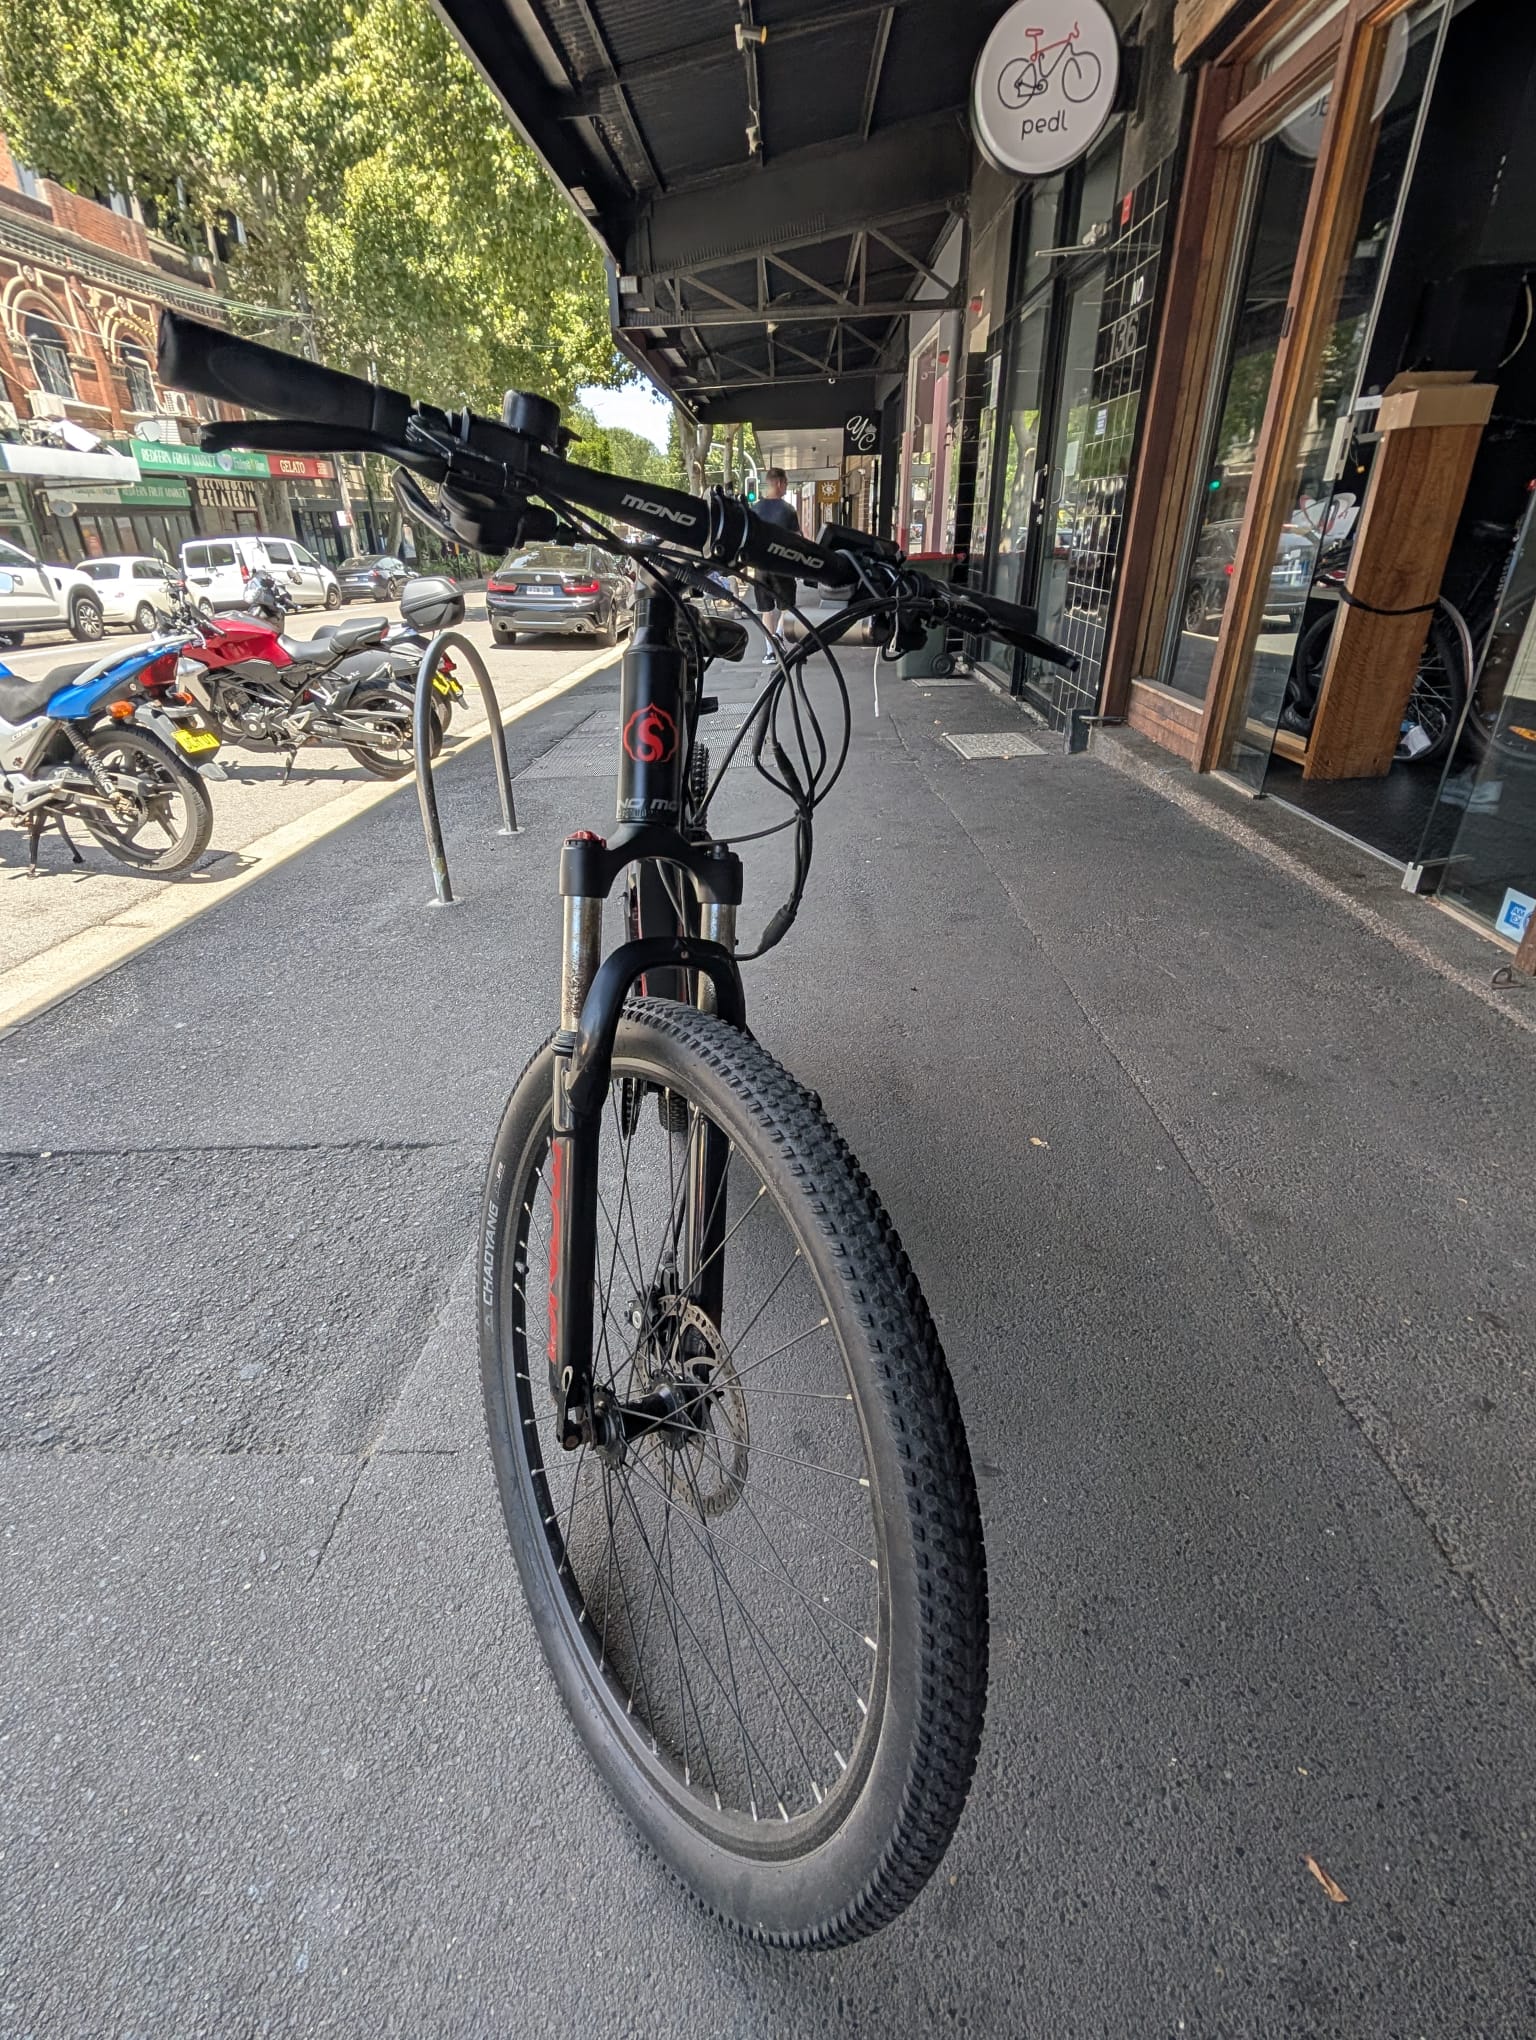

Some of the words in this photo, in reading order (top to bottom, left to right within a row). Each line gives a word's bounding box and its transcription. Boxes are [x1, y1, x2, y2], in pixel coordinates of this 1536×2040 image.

[1021, 110, 1068, 141] pedl
[1130, 276, 1144, 306] NO
[1109, 312, 1139, 362] 136
[141, 448, 172, 465] REDFERN
[172, 451, 190, 465] FRUIT
[191, 453, 217, 468] MARKET
[279, 459, 306, 474] GELATO
[197, 489, 257, 508] GELATERIA
[620, 494, 697, 528] MONO
[767, 542, 825, 570] MONO
[482, 1199, 500, 1307] CHAOYANG
